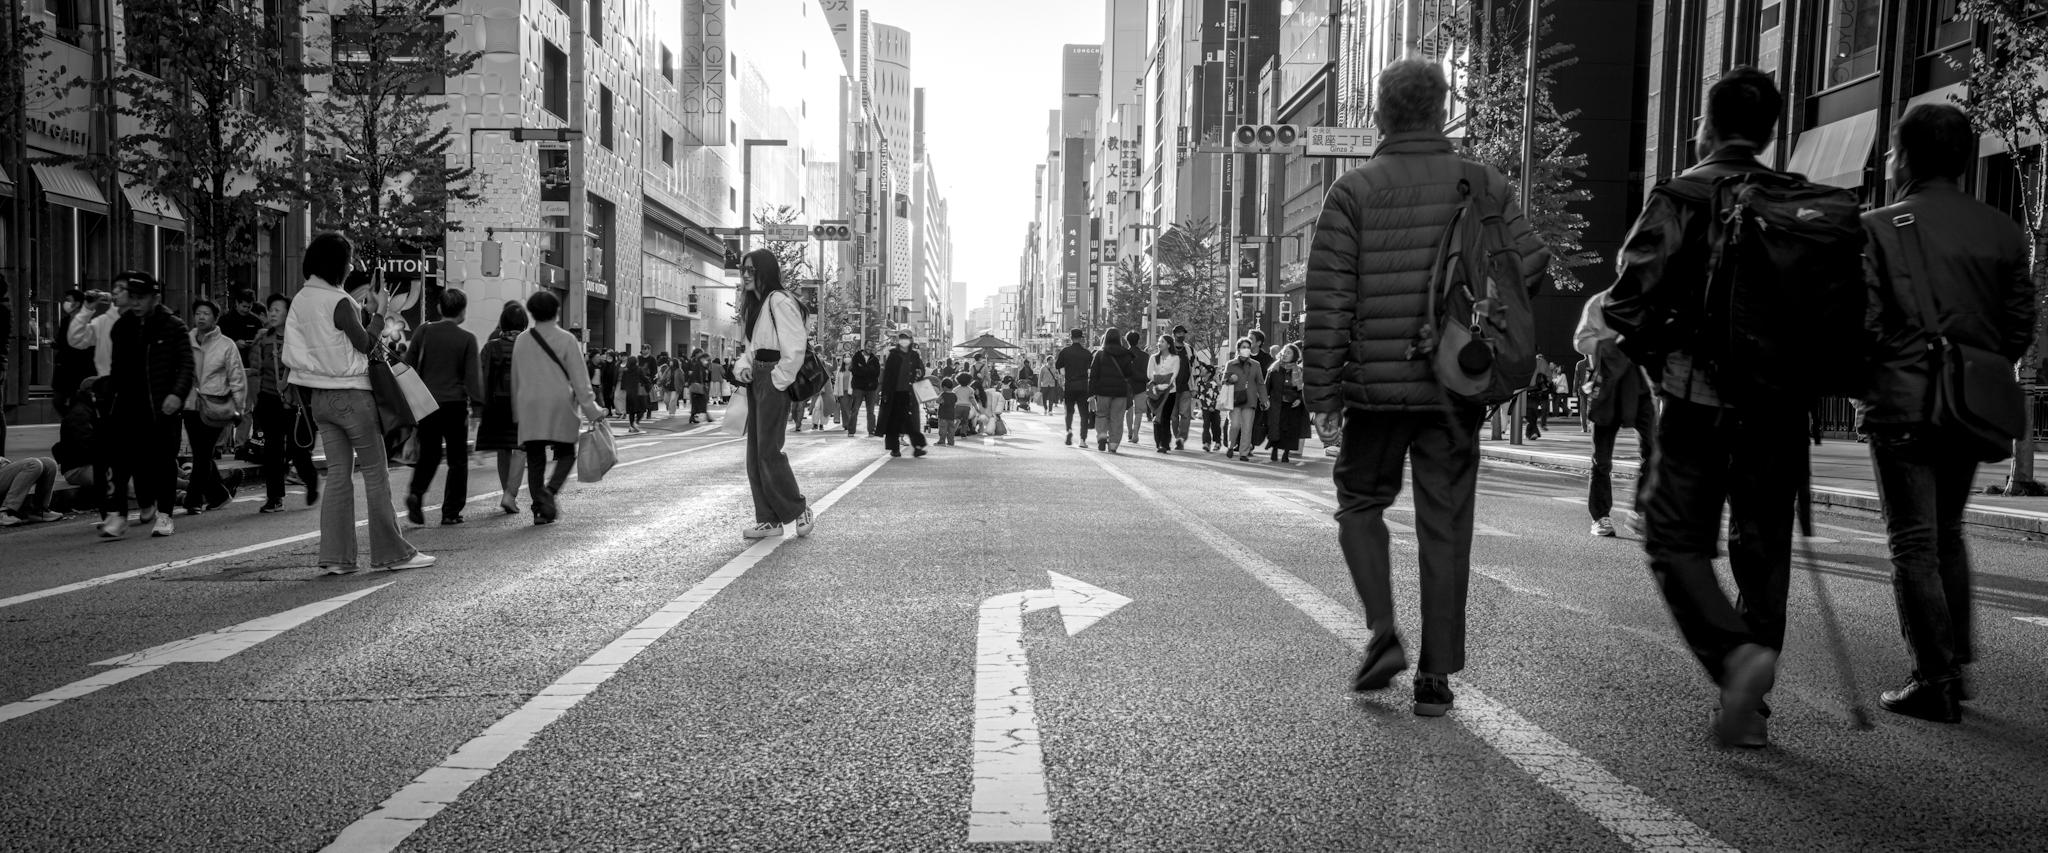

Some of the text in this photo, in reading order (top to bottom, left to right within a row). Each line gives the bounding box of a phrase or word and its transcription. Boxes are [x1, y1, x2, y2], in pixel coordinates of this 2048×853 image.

[1312, 134, 1372, 147] 銀座二丁目
[1106, 136, 1119, 205] 教文館
[1105, 243, 1116, 259] 本
